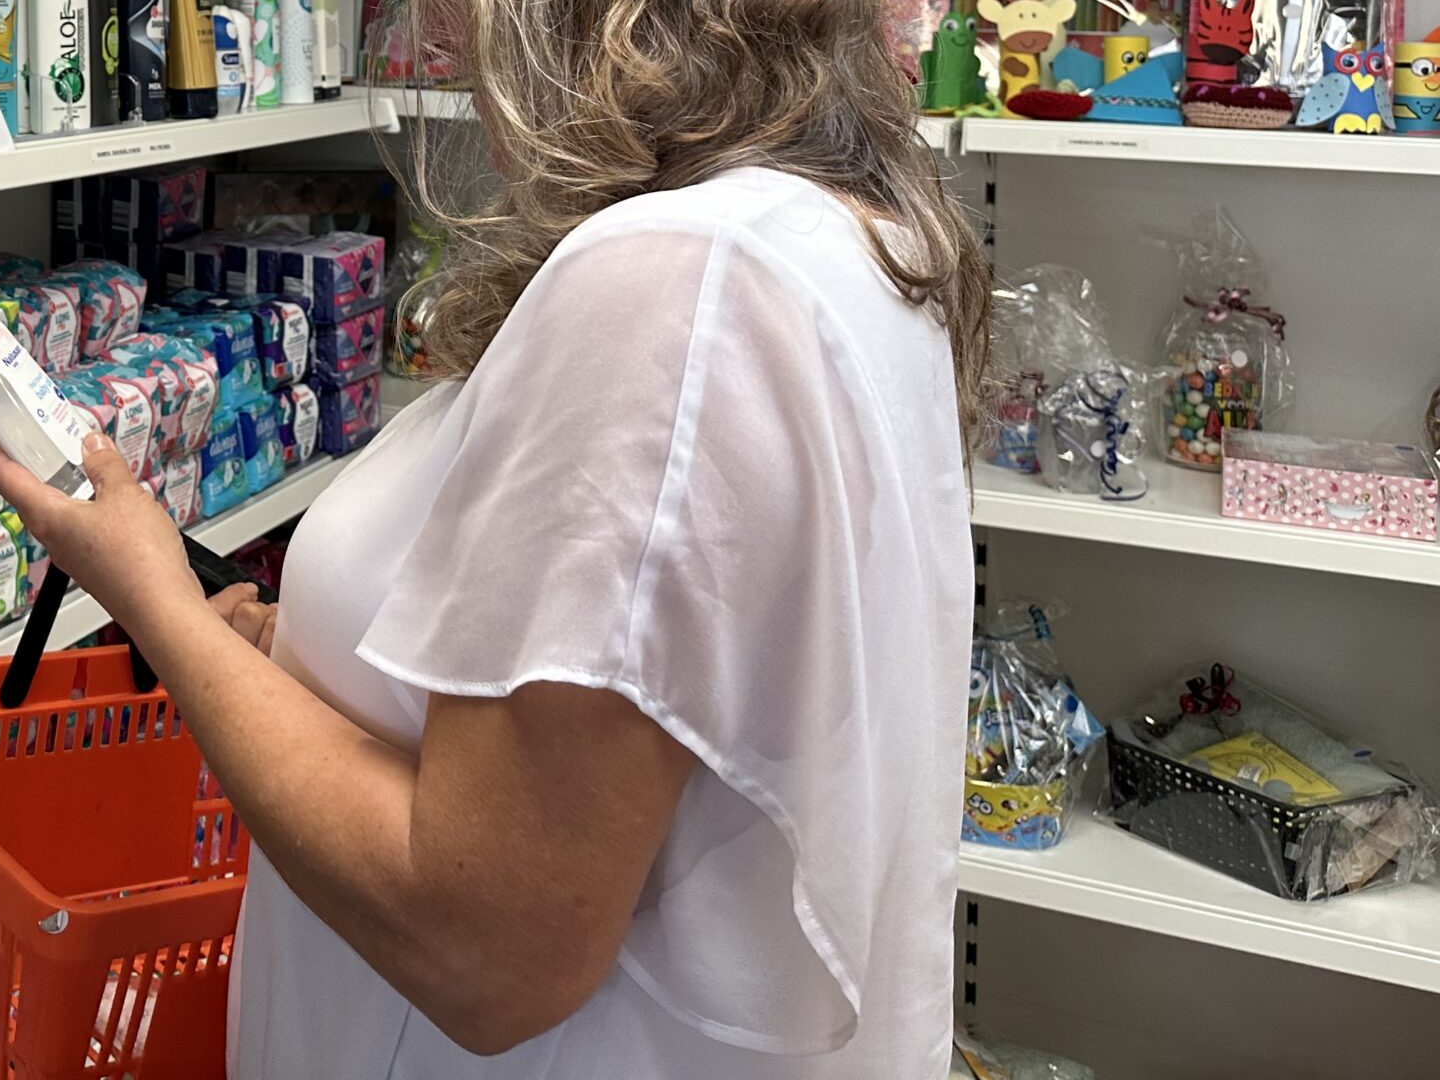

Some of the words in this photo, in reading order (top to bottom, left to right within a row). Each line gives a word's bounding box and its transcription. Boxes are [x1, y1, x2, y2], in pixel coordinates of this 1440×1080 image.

[60, 10, 76, 61] ALOE
[124, 404, 144, 420] LONG
[210, 432, 238, 458] always
